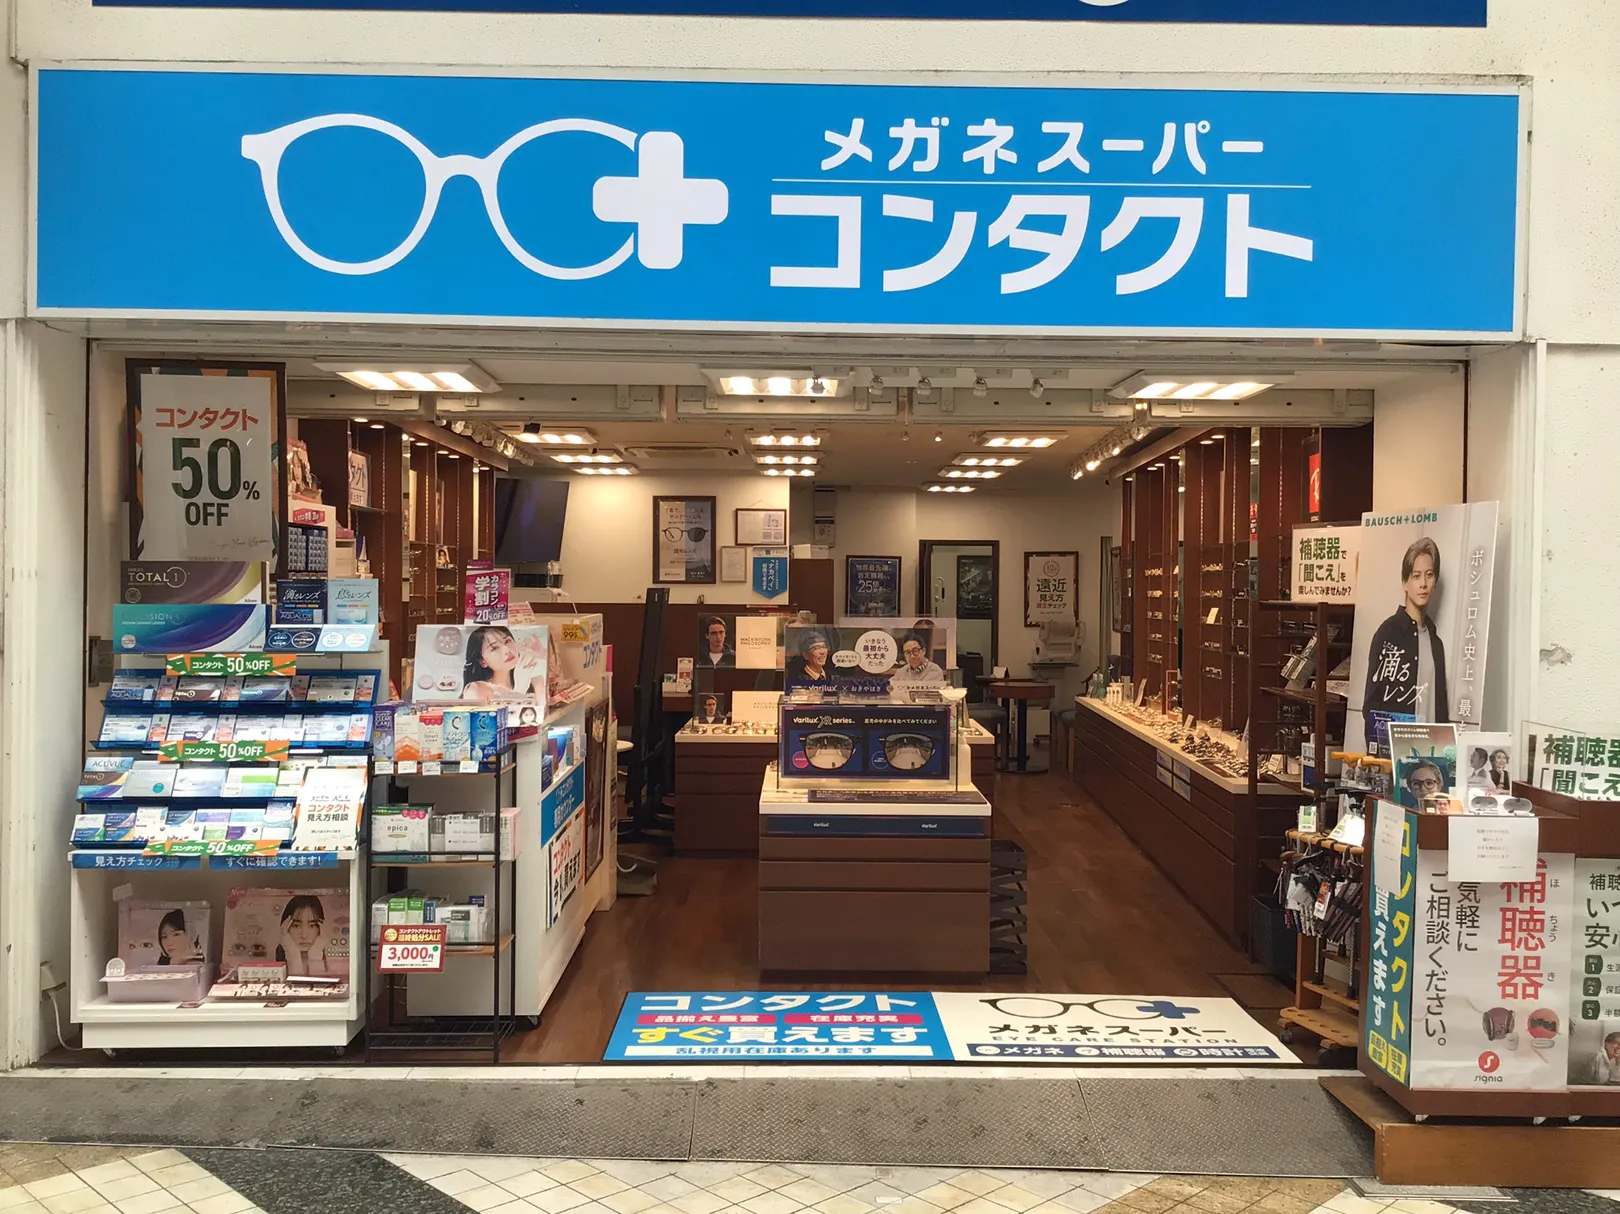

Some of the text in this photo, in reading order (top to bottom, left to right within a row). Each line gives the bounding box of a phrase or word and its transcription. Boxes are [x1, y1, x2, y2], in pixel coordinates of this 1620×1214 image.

[820, 116, 1265, 176] メガネスーパー
[769, 192, 1314, 299] コンタクト
[155, 407, 259, 432] コンタクト
[184, 502, 230, 527] OFF
[1299, 537, 1347, 561] 補聴器で
[127, 572, 170, 583] TOTAL
[1298, 563, 1347, 583] 「聞こえ」を
[474, 575, 490, 606] 学割
[490, 574, 499, 606] カラコン
[1036, 578, 1067, 593] 遠近
[1039, 593, 1064, 602] 見え方
[865, 652, 886, 660] 大丈夫
[191, 660, 224, 670] コンタクト
[1372, 645, 1411, 683] 滴る
[1382, 682, 1429, 705] レンズ
[184, 746, 217, 756] コンタクト
[91, 760, 125, 768] ACUVUE
[307, 803, 350, 813] コンタクト
[306, 813, 349, 822] 見え方相談
[387, 824, 408, 832] epica
[171, 843, 204, 853] コンタクト
[94, 856, 163, 868] 見え方チェック
[225, 855, 322, 868] すぐに確認できます!
[1549, 877, 1560, 889] ほ
[1455, 881, 1481, 953] 気軽に
[1548, 914, 1558, 943] ちょう
[1424, 870, 1450, 1047] ご相談ください。
[1590, 963, 1596, 972] 1
[1546, 971, 1556, 983] き
[1588, 985, 1594, 995] 2
[640, 994, 917, 1011] コンタクト
[654, 1014, 899, 1023] 品揃え豊富 在庫充実
[1587, 1008, 1593, 1017] 3
[632, 1026, 928, 1044] すぐ買えます
[988, 1023, 1227, 1037] メガネスーパー
[675, 1046, 877, 1056] 乱視用在庫あります
[1003, 1046, 1064, 1055] メガネ
[1100, 1047, 1166, 1057] 補聴器
[1197, 1048, 1244, 1057] 時計
[1472, 1074, 1503, 1085] signia
